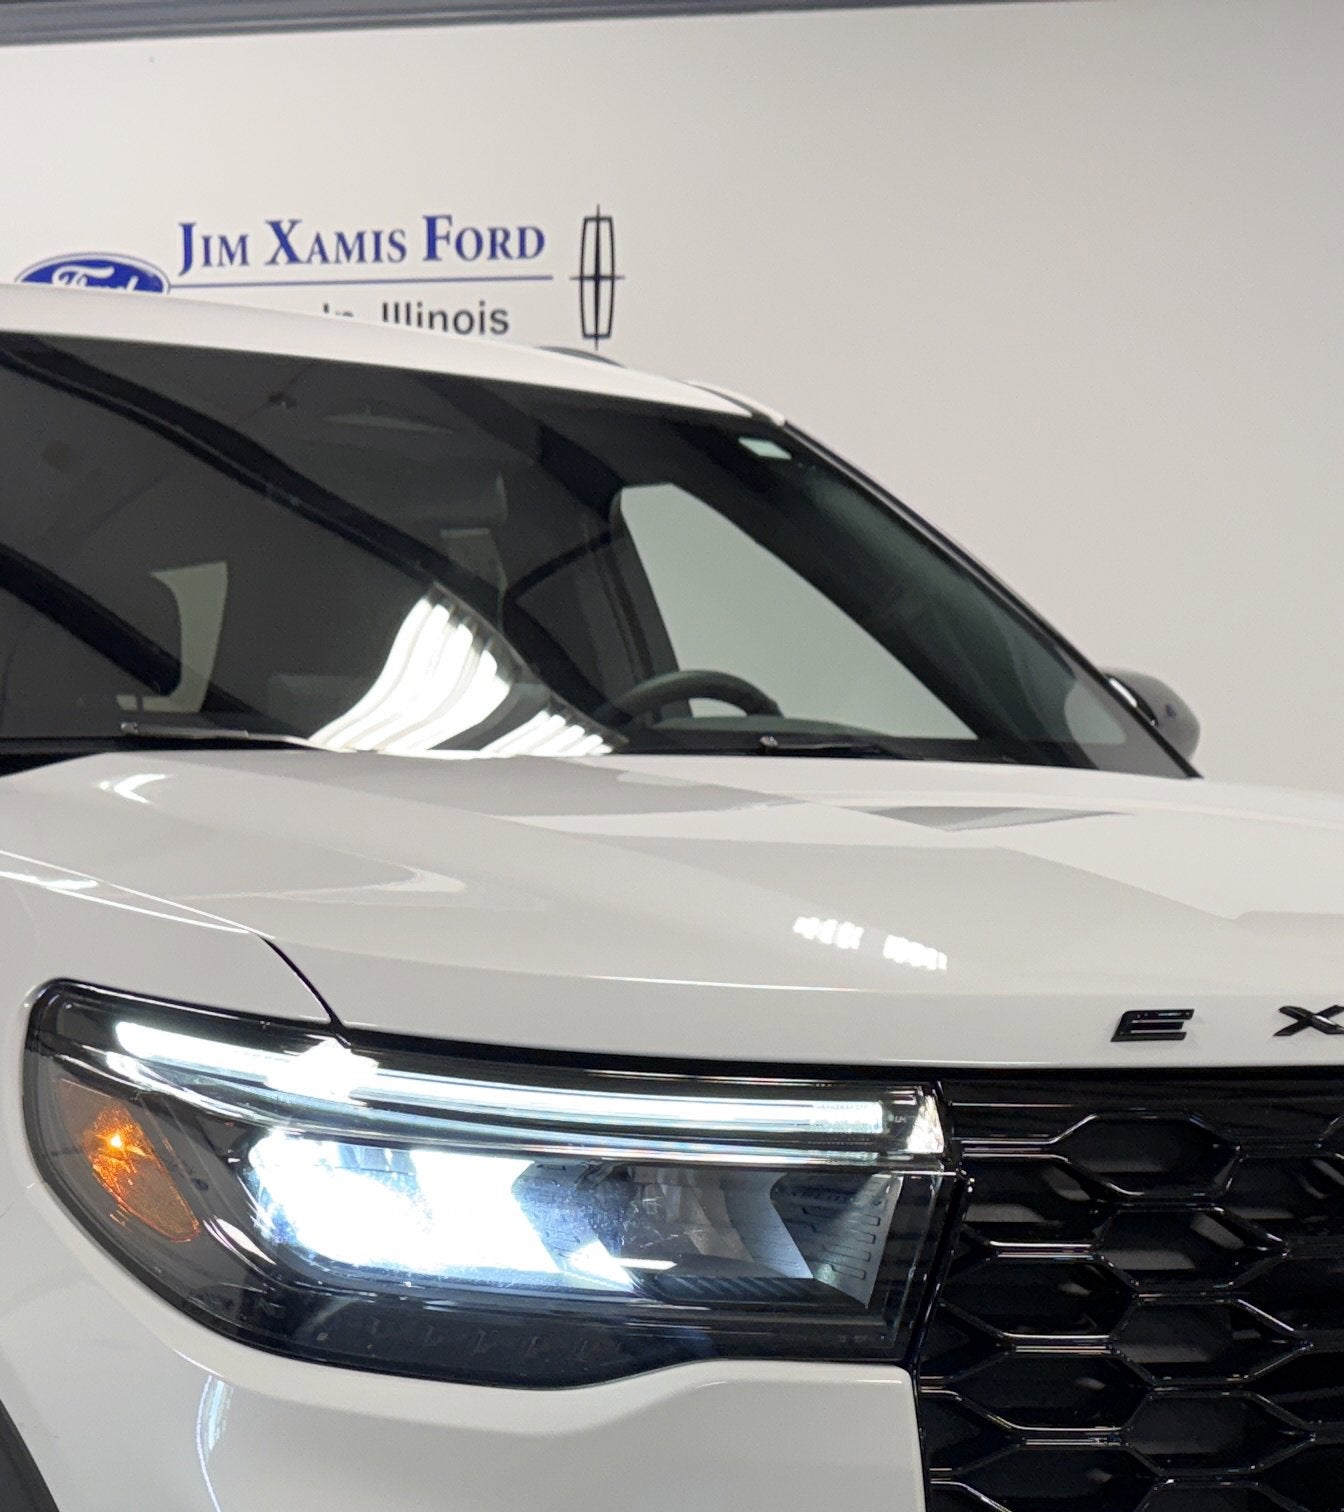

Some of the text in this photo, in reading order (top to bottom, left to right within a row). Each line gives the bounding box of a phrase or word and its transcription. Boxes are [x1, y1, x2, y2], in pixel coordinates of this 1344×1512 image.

[178, 214, 546, 277] JIM XAMIS FORD
[382, 300, 510, 336] Illinois
